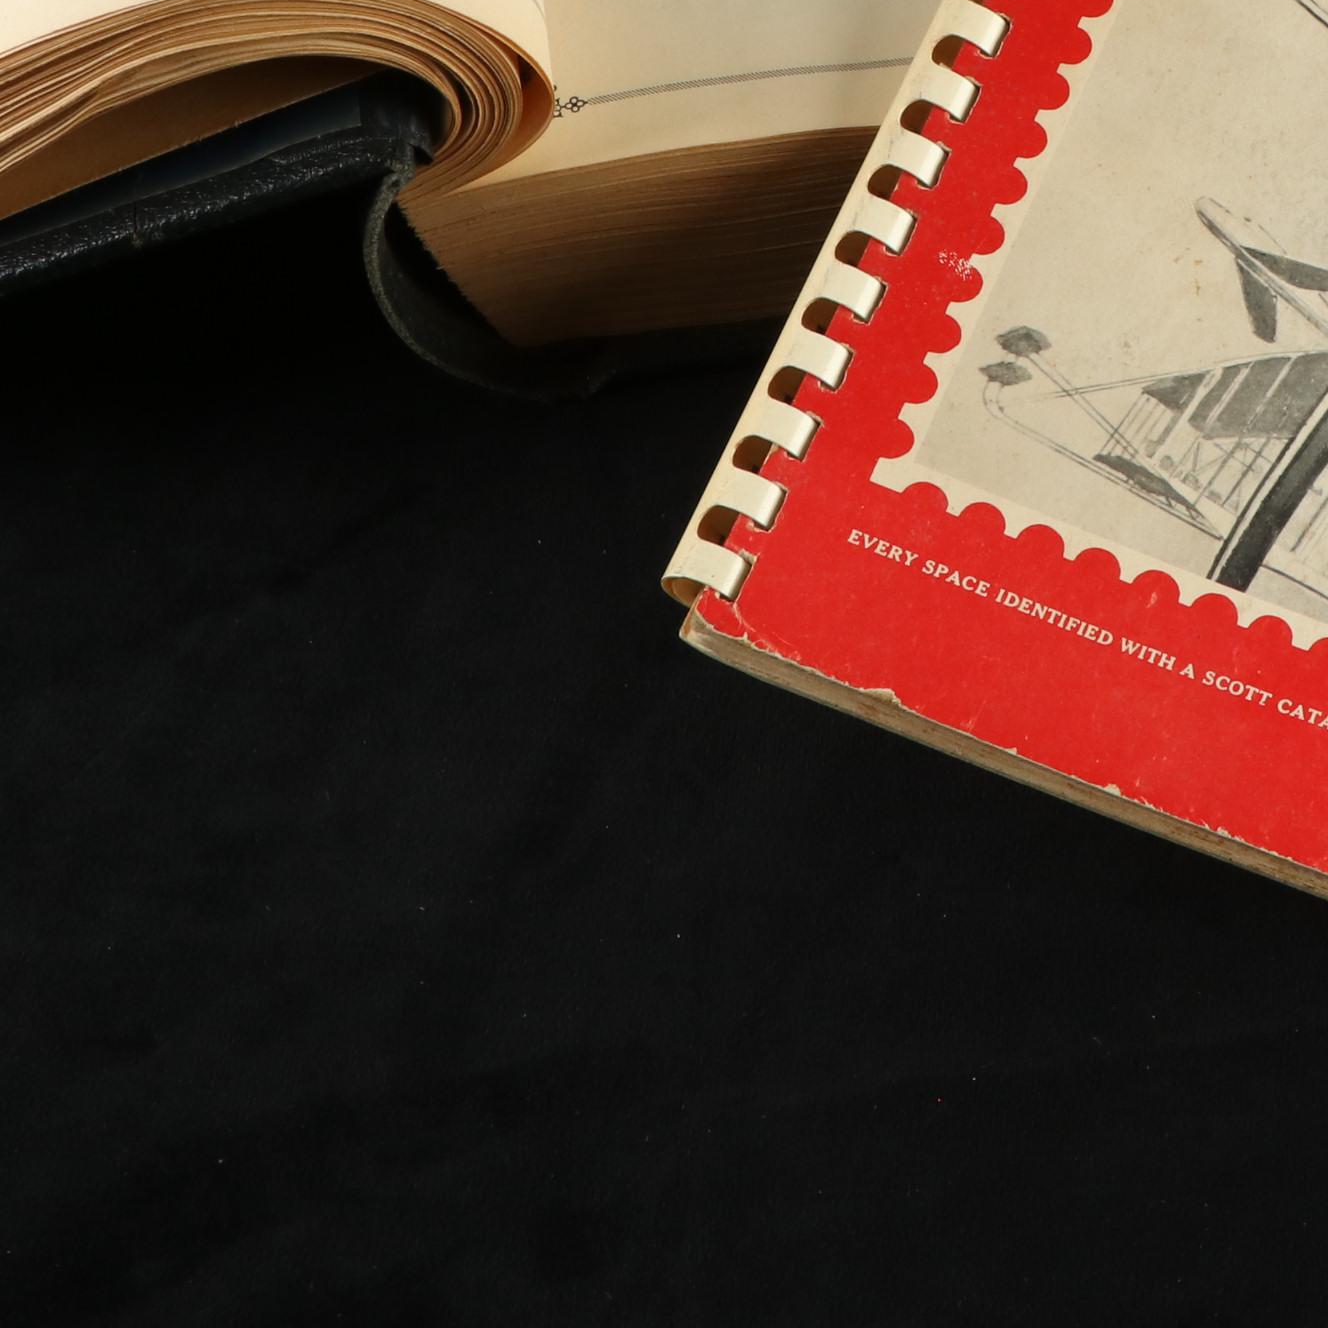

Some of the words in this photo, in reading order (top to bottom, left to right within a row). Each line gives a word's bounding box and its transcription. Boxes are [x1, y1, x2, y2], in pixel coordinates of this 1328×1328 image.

[847, 528, 920, 568] EVERY
[921, 559, 991, 598] SPACE
[994, 588, 1115, 647] IDENTIFIED
[1119, 637, 1178, 671] WITH
[1178, 662, 1197, 680] A
[1201, 670, 1273, 707] SCOTT
